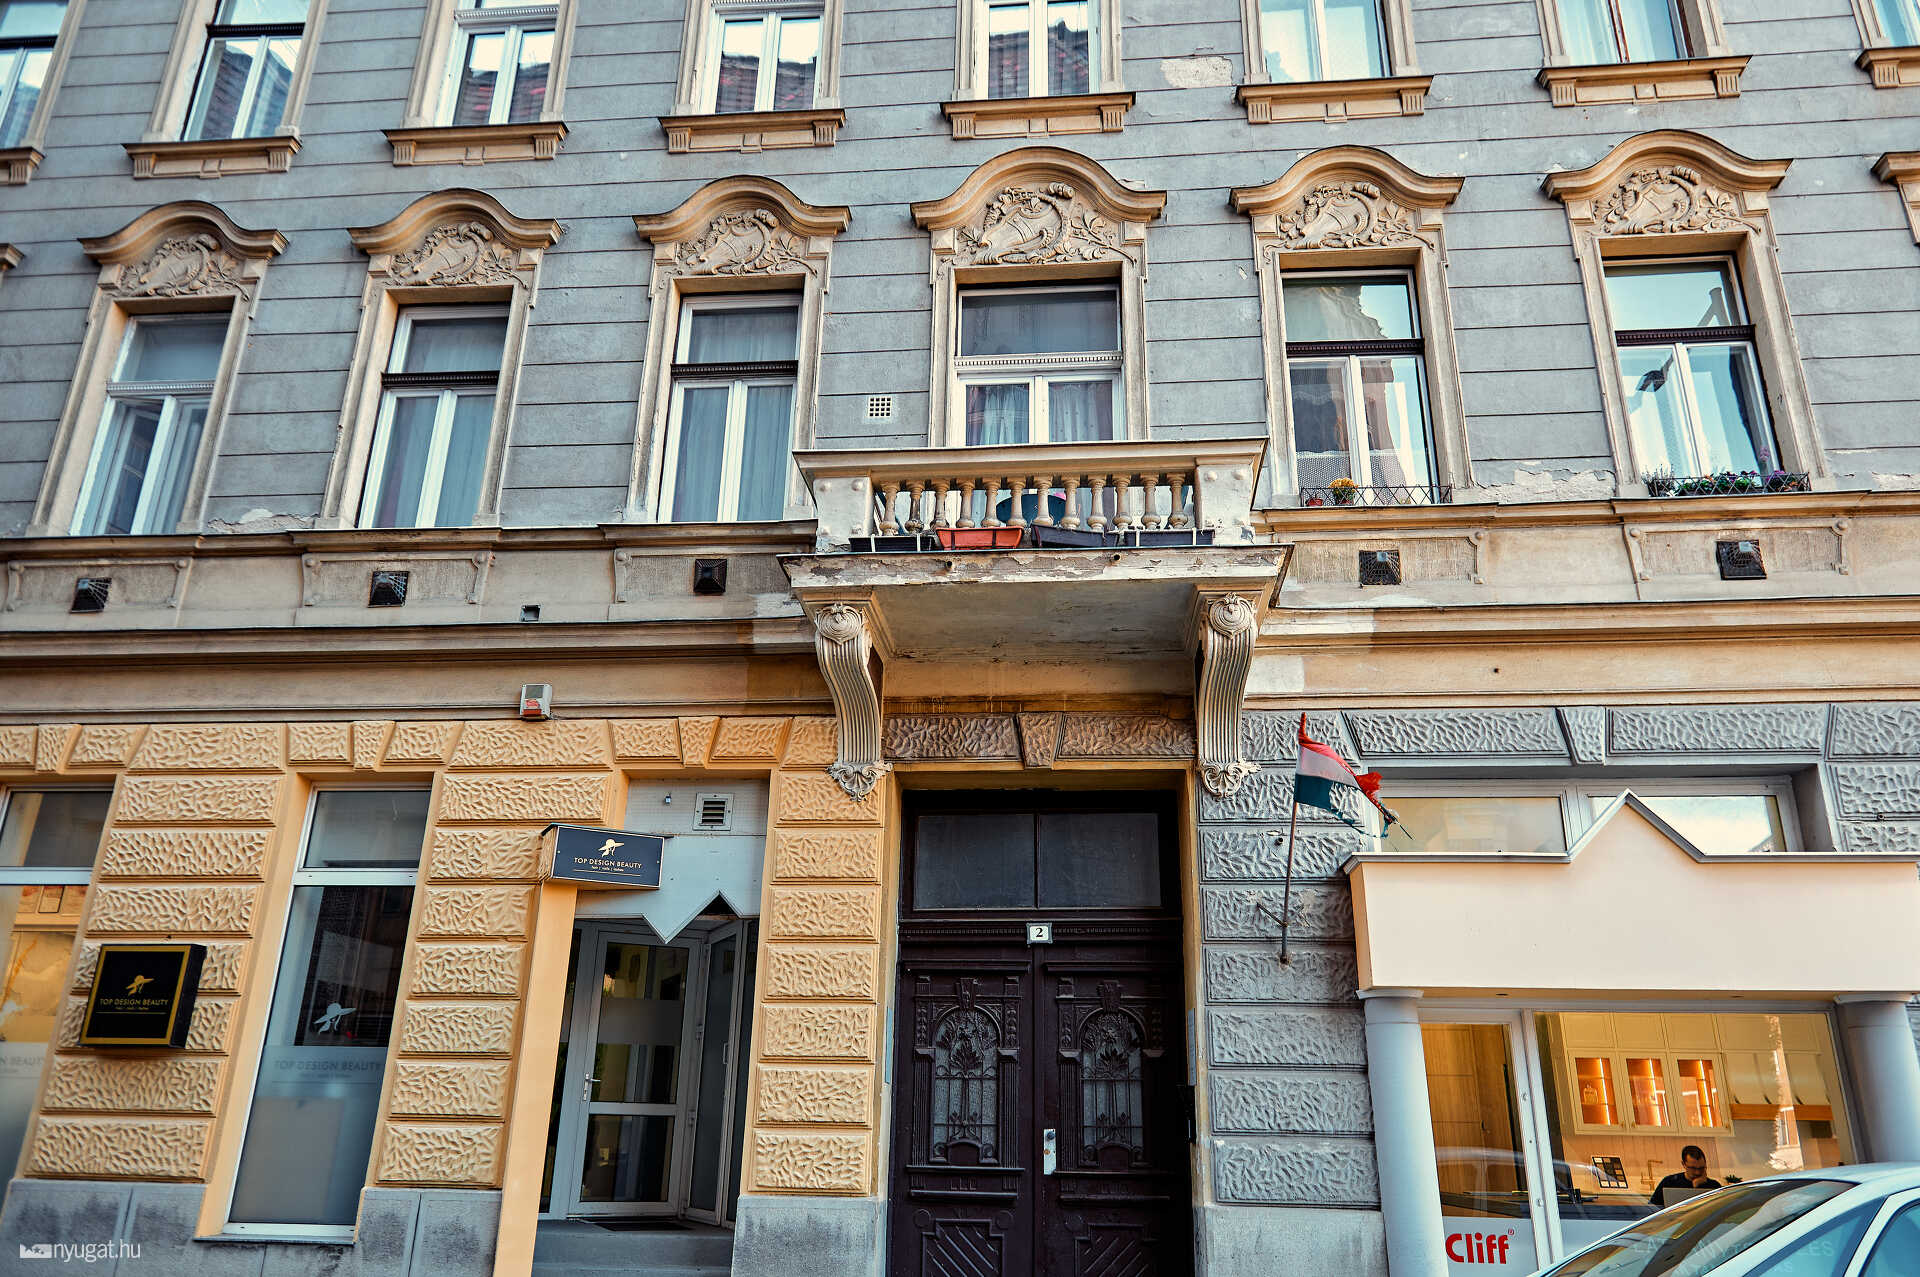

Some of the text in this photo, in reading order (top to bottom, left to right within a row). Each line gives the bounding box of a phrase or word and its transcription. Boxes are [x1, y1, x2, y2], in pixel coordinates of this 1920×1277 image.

[574, 857, 642, 869] TOP DESIGN BEAUTY
[1035, 927, 1044, 938] 2
[100, 998, 113, 1006] TOP
[114, 998, 141, 1006] DESIGN
[274, 1060, 294, 1070] TOP
[297, 1061, 338, 1071] DESIGN
[1445, 1232, 1509, 1265] Cliff
